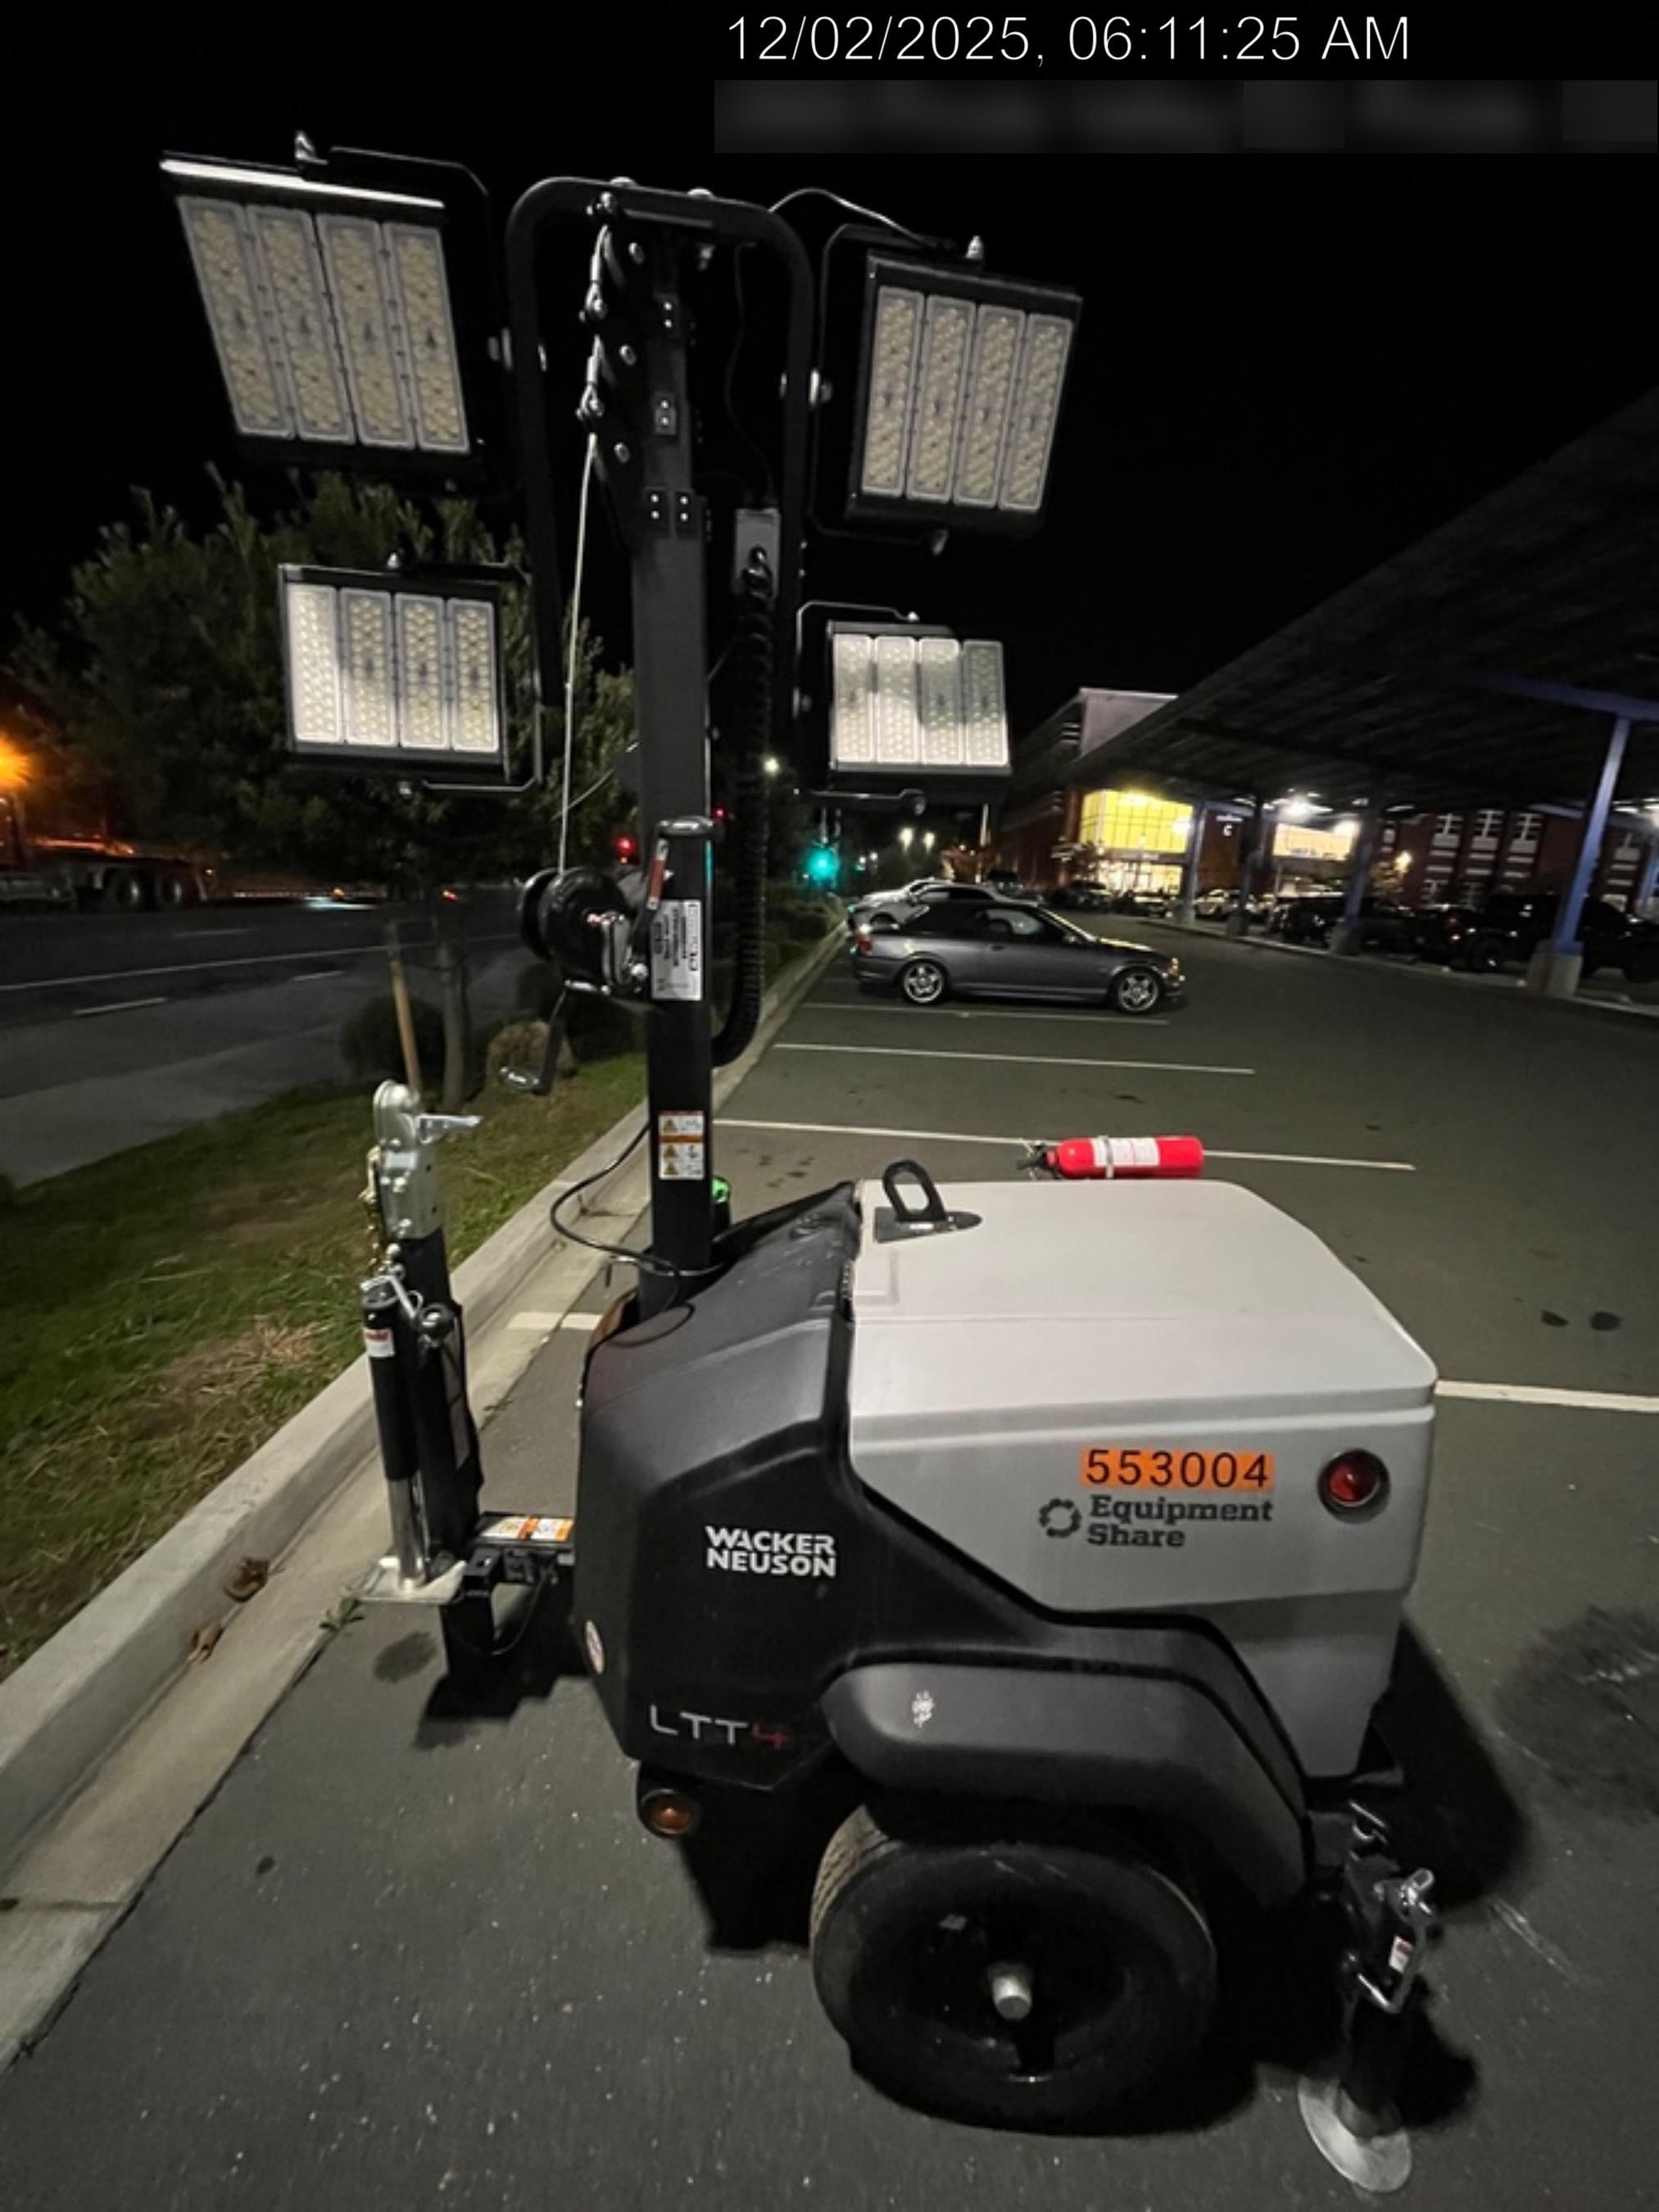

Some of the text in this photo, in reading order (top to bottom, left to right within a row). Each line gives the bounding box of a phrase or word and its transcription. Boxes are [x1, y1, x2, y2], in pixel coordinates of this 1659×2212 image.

[1086, 1448, 1269, 1488] 553004
[1090, 1494, 1273, 1525] Equipment
[705, 1525, 836, 1556] WACKER
[1087, 1523, 1185, 1547] Share
[706, 1547, 836, 1578] NEUSON
[650, 1704, 788, 1750] LTT4
